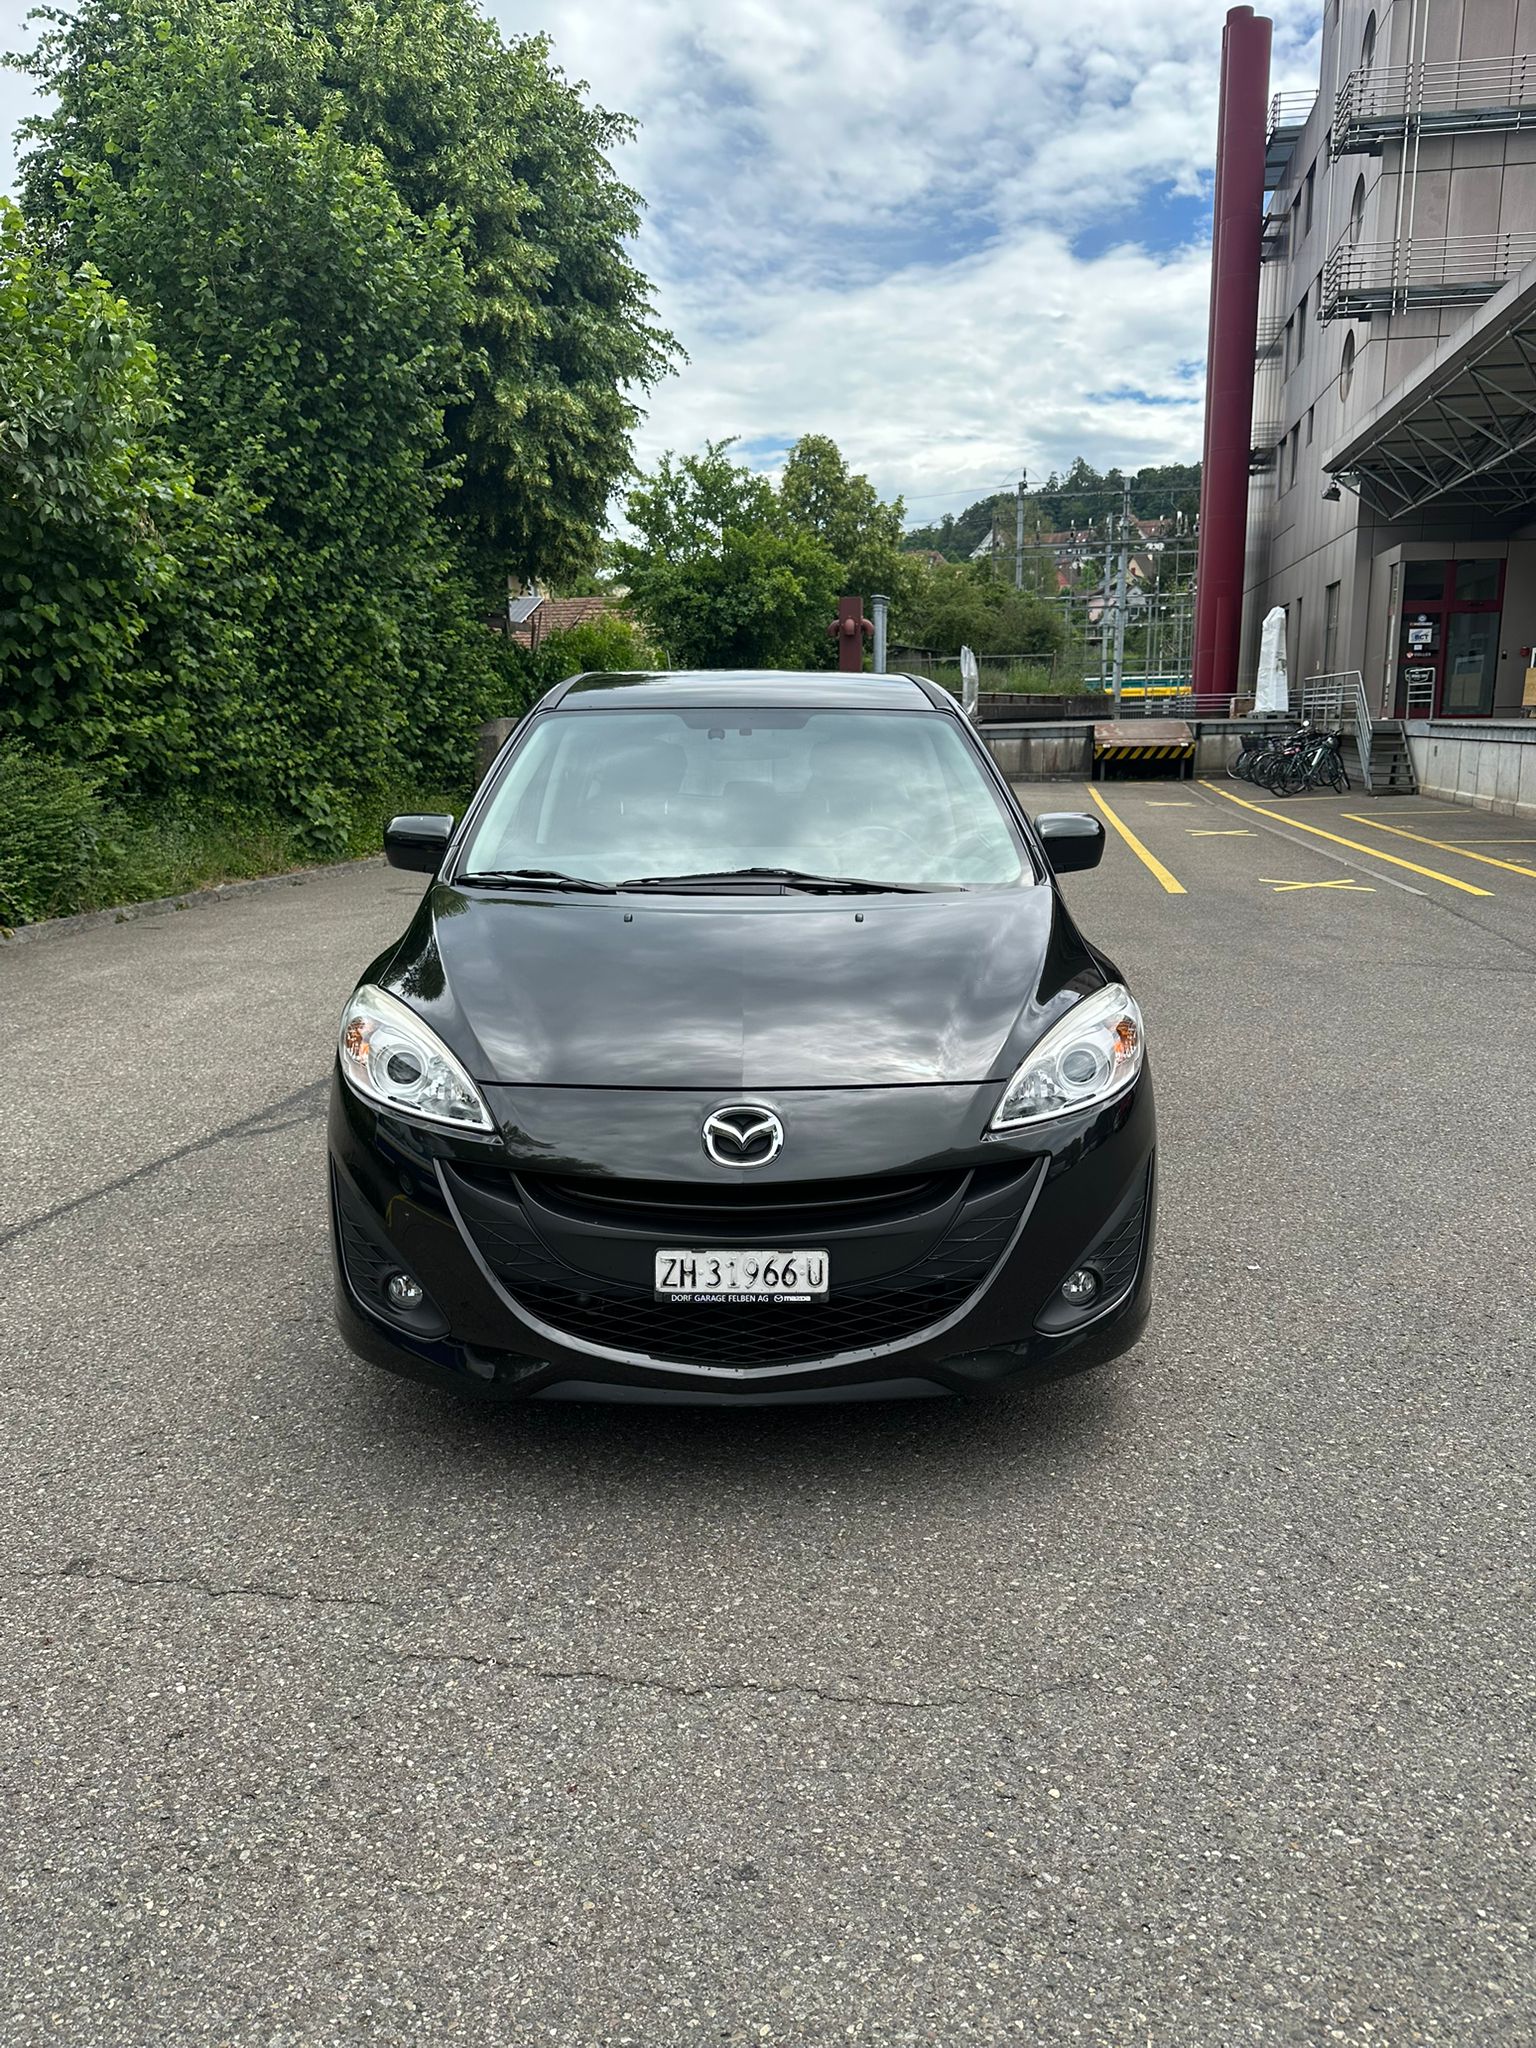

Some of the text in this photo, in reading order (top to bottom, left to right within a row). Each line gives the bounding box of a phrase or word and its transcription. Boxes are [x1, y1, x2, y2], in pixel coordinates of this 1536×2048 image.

[660, 1258, 697, 1288] ZH
[807, 1257, 824, 1288] U
[671, 1294, 692, 1302] DORF
[694, 1294, 726, 1302] GARAGE
[728, 1294, 756, 1302] FELBEN
[757, 1294, 769, 1302] AG
